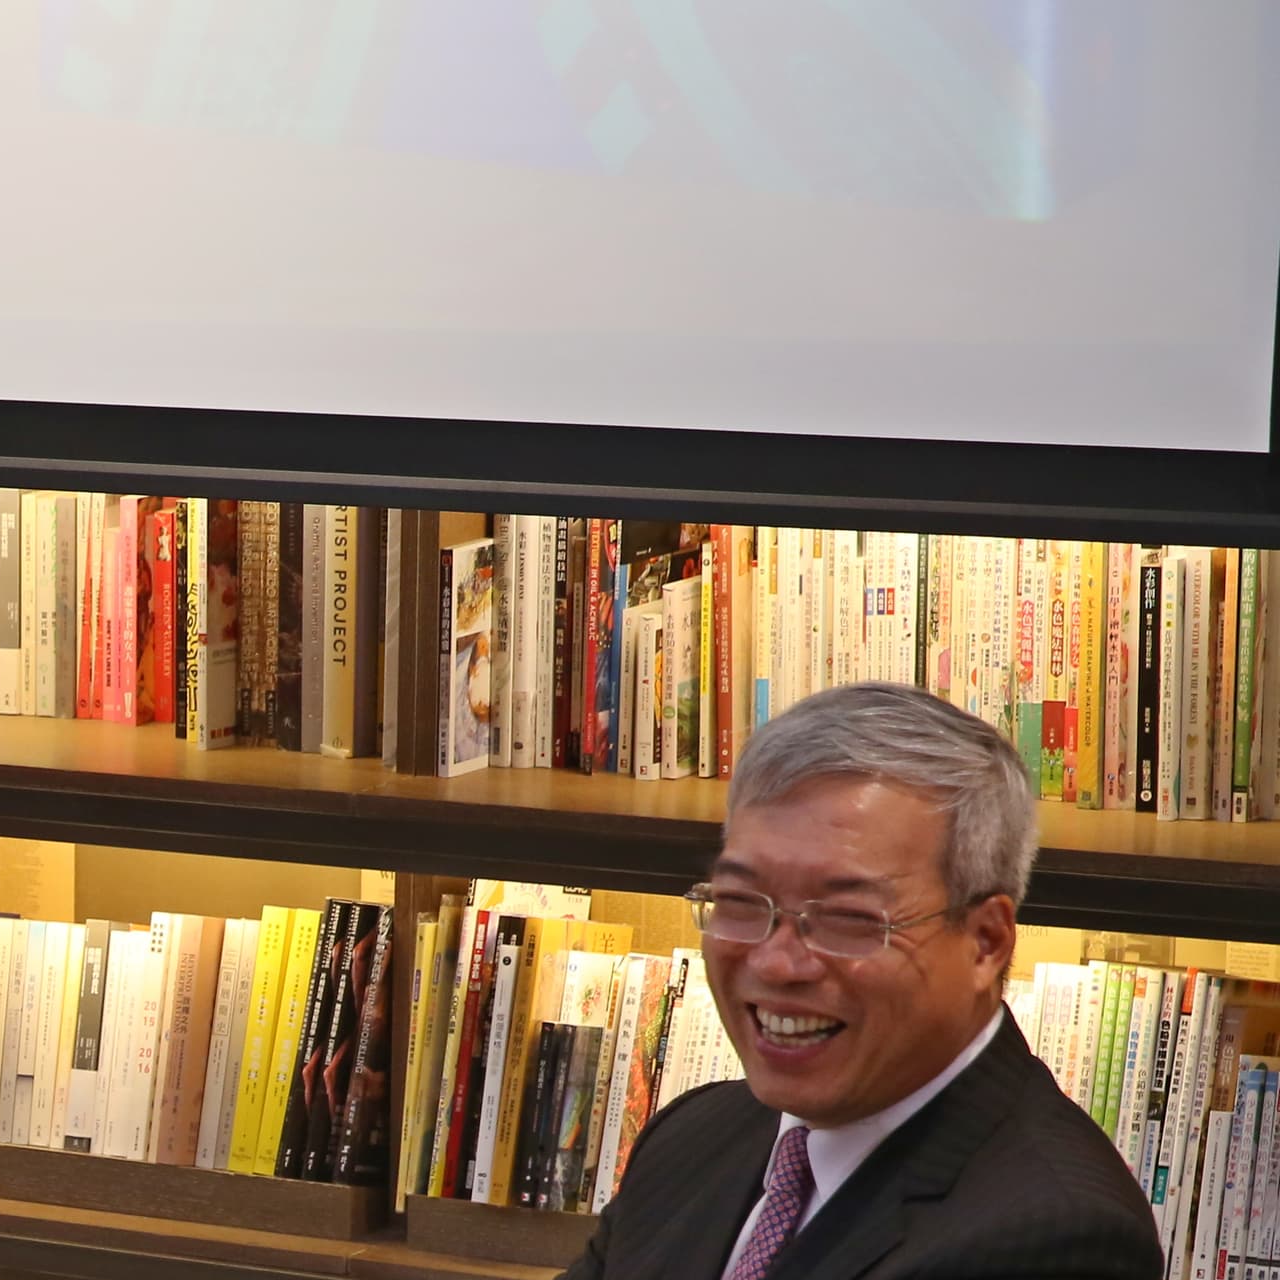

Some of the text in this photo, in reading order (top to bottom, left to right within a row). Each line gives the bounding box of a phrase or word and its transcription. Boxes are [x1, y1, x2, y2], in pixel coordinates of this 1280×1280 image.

[265, 524, 278, 674] YEARS ARTWORKS
[332, 505, 348, 667] RTIST PROJECT
[1145, 567, 1156, 609] 水彩創作
[1191, 559, 1202, 619] WATERCOLOR
[587, 604, 597, 641] ACRYLIC
[1191, 622, 1200, 646] WITH
[1084, 617, 1094, 748] NATURE DRAWING WATERCOLOR
[1189, 674, 1198, 691] THE
[1188, 693, 1198, 726] FOREST
[143, 1017, 155, 1027] 15
[144, 1001, 157, 1011] 20
[139, 1047, 152, 1058] 20
[354, 1022, 371, 1074] MODELING
[138, 1063, 150, 1074] 16
